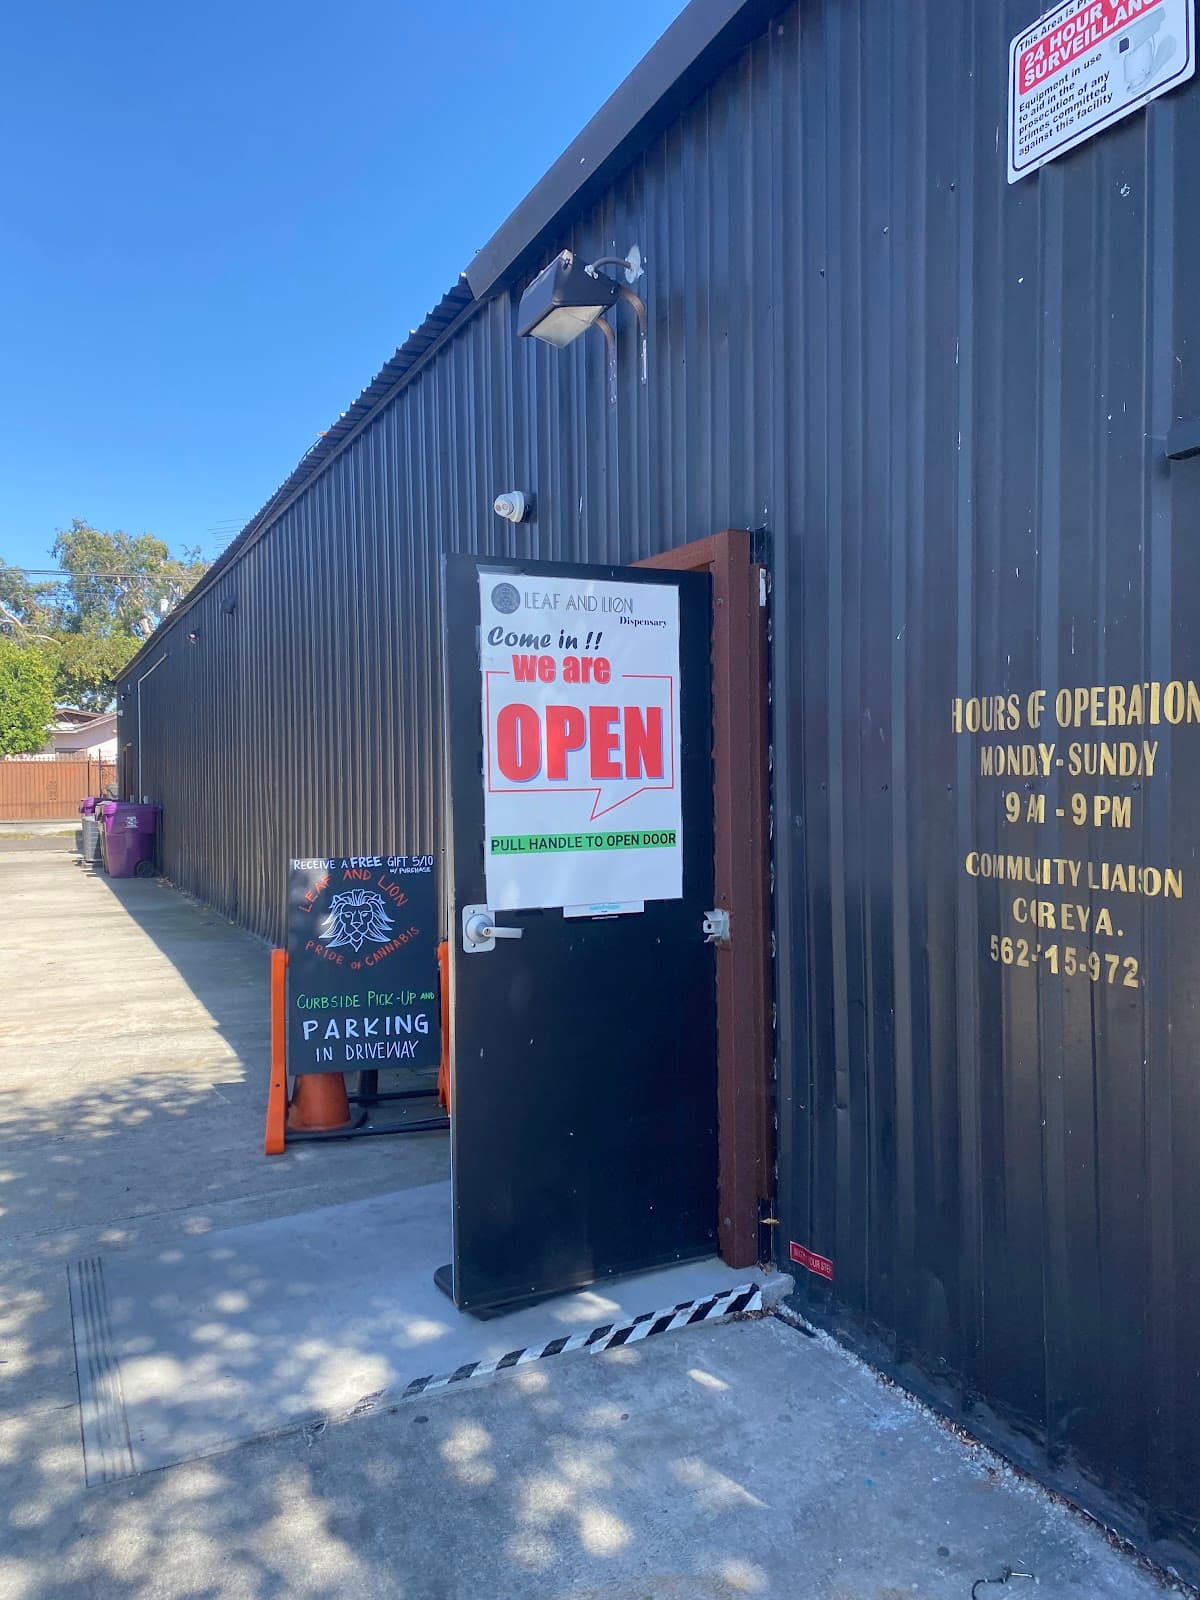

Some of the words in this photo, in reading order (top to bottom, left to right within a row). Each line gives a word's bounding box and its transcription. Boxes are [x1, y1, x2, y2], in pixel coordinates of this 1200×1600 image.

[1019, 34, 1038, 52] This
[1041, 17, 1063, 36] Area
[1065, 8, 1074, 18] is
[1024, 46, 1045, 71] 24
[1050, 3, 1103, 50] HOUR
[1024, 0, 1161, 87] SURVEILLAN
[1019, 74, 1068, 112] Equipment
[1071, 67, 1080, 78] in
[1083, 54, 1102, 69] use
[1019, 114, 1028, 123] to
[1030, 102, 1045, 116] aid
[1047, 94, 1056, 105] in
[1059, 82, 1075, 97] the
[1019, 94, 1075, 136] prosecution
[1077, 83, 1088, 96] of
[1091, 71, 1110, 88] any
[1019, 123, 1050, 145] crimes
[1052, 83, 1107, 123] committed
[1019, 129, 1053, 155] against
[1056, 116, 1075, 133] this
[1077, 92, 1113, 120] facility
[524, 591, 561, 610] LEAF
[566, 594, 598, 613] AND
[619, 616, 667, 628] Dispensary
[488, 626, 551, 650] Come
[558, 629, 578, 650] in
[511, 654, 557, 683] we
[562, 656, 611, 684] are
[952, 693, 1021, 734] HOURS
[497, 703, 664, 783] OPEN
[1005, 791, 1020, 823] 9
[1071, 792, 1087, 826] 9
[1094, 795, 1132, 828] PM
[491, 839, 525, 852] PULL
[529, 836, 582, 850] HANDLE
[586, 835, 603, 848] TO
[607, 834, 640, 847] OPEN
[643, 832, 676, 845] DOOR
[293, 859, 336, 870] RECEIVE
[341, 860, 348, 869] A
[350, 856, 383, 869] FREE
[387, 856, 408, 867] GIFT
[298, 874, 331, 913] LEAF
[343, 869, 372, 880] AND
[377, 874, 409, 907] LION
[305, 940, 344, 964] PRIDE
[365, 926, 420, 966] CANNABIS
[297, 994, 361, 1009] CURBSIDE
[420, 991, 435, 1000] AND
[303, 1013, 429, 1041] PARKING
[316, 1046, 333, 1062] IN
[345, 1040, 419, 1061] DRIVEWAY
